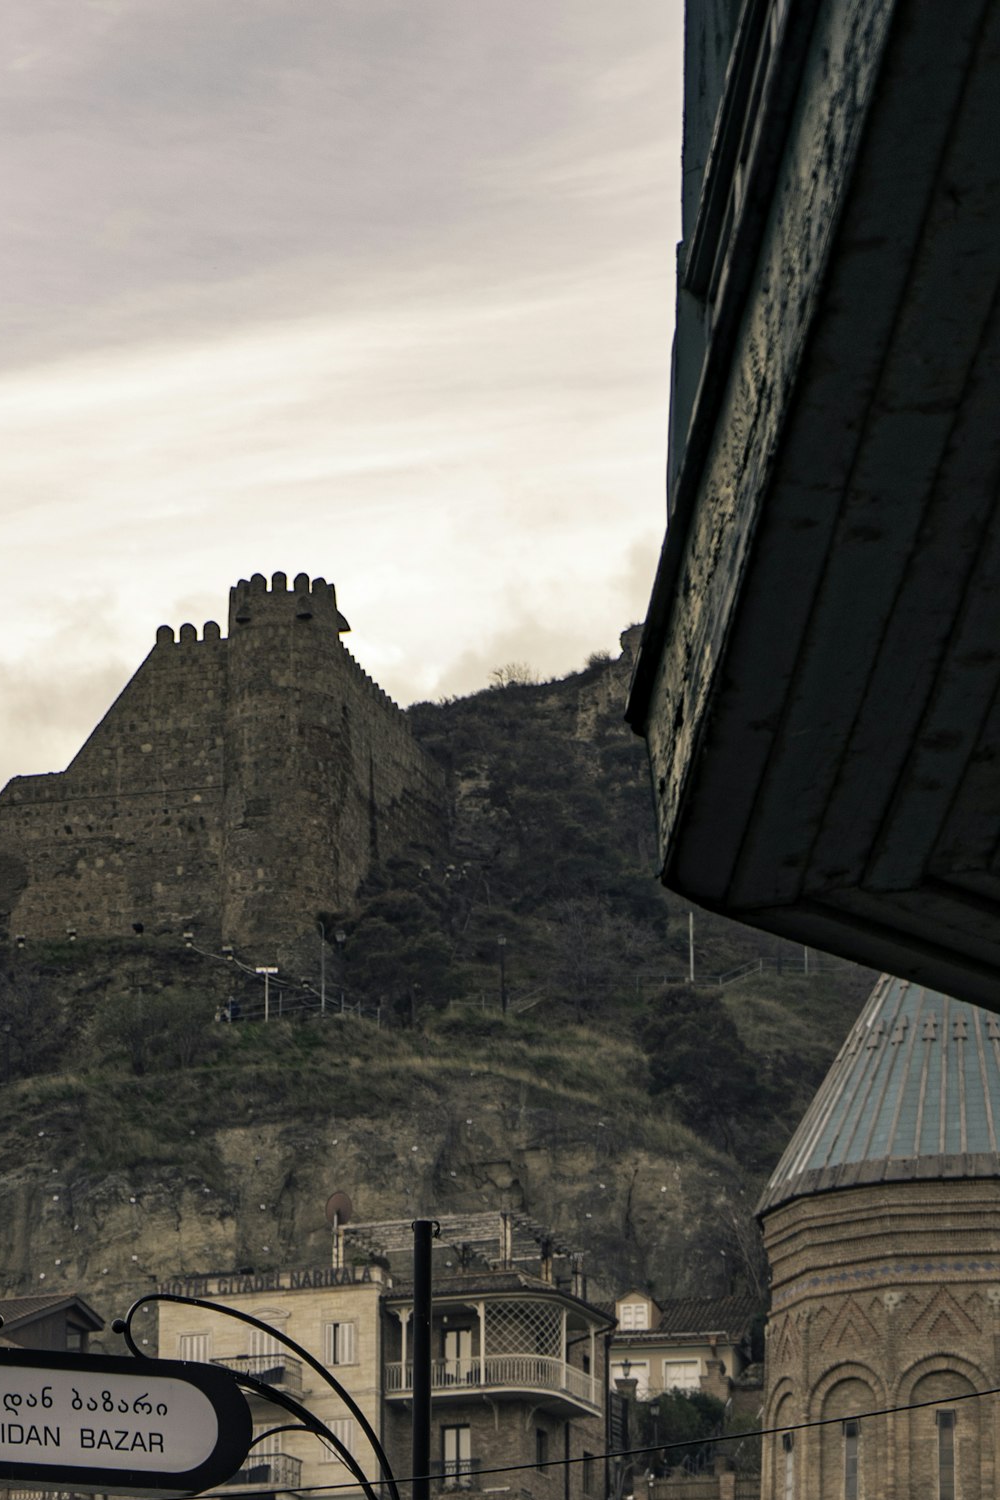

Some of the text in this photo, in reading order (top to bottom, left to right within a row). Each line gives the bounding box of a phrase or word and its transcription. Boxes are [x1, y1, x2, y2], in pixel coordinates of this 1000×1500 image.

[157, 1266, 373, 1296] HOTEL CITADEL NARIKALA
[71, 1387, 168, 1416] ბაზარი
[80, 1427, 164, 1453] BAZAR
